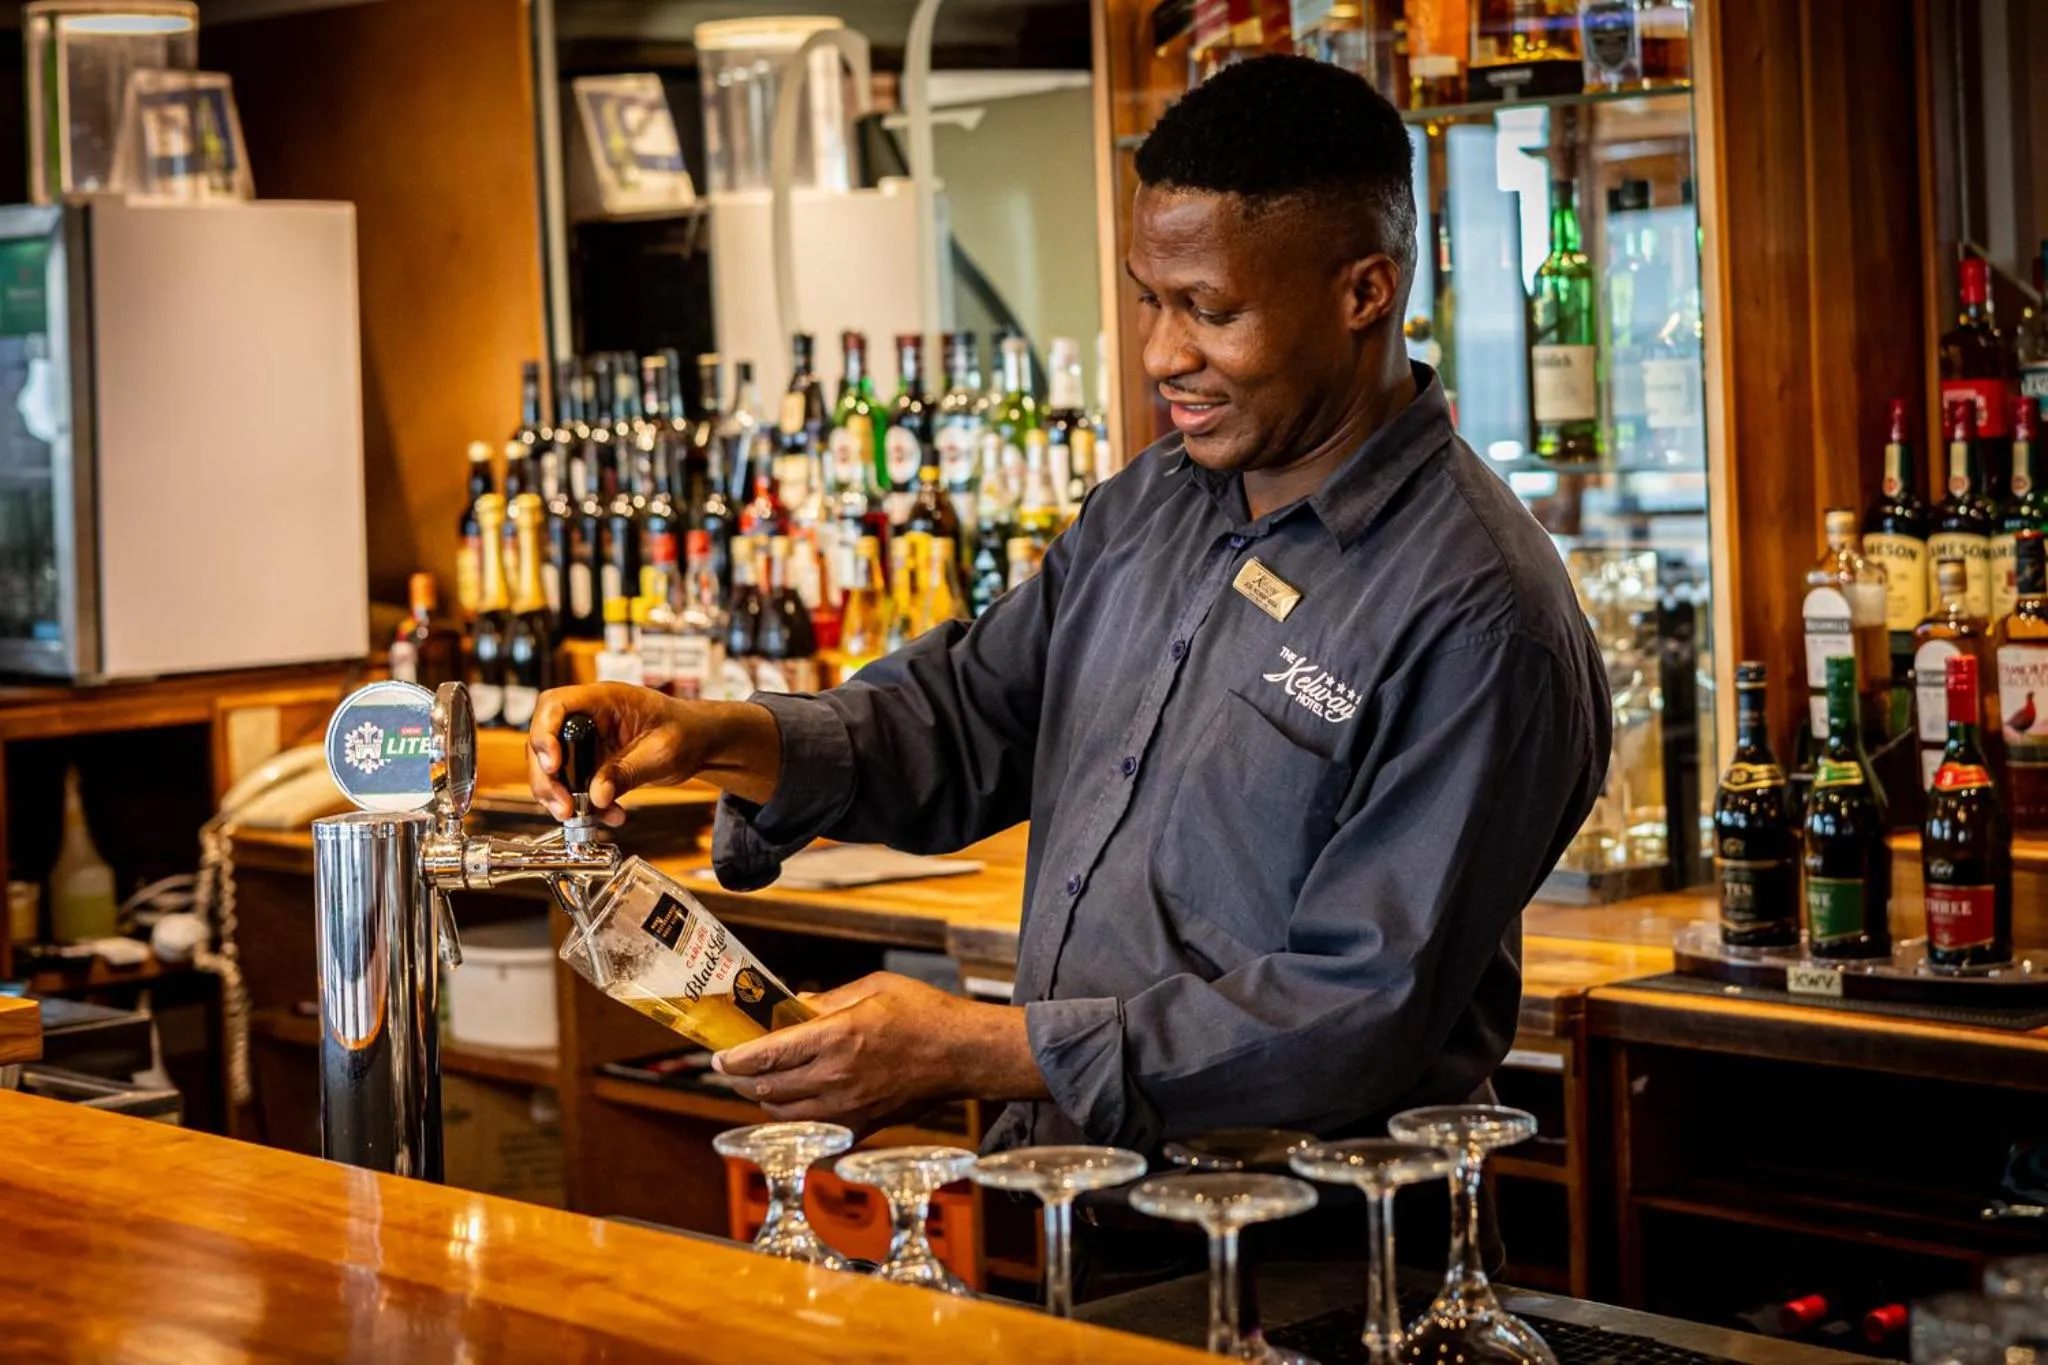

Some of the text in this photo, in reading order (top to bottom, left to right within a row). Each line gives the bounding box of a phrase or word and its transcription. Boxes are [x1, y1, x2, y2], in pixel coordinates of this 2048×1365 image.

[1279, 645, 1298, 663] THE
[1263, 657, 1358, 723] Kelway
[1295, 692, 1324, 717] HOTEL
[686, 926, 709, 969] CARLING
[684, 951, 720, 1003] Black
